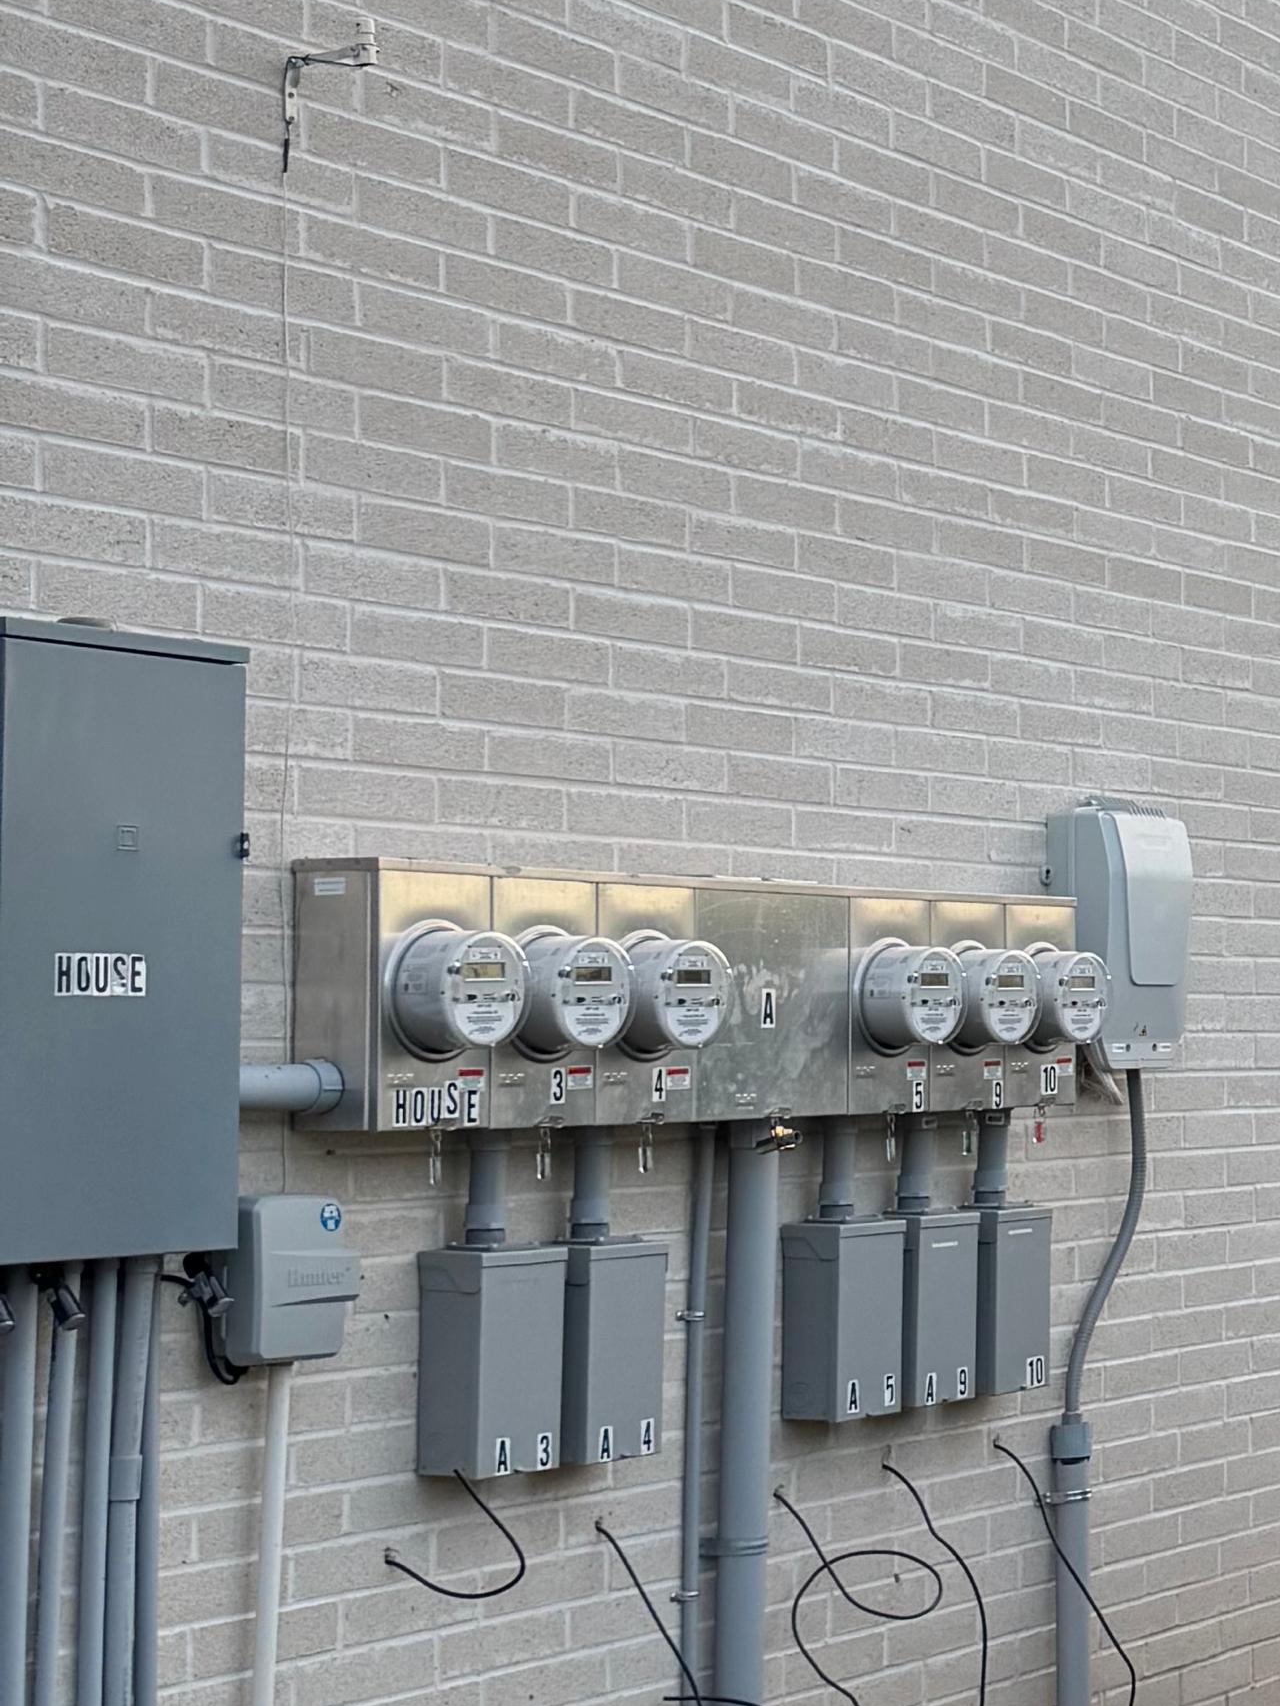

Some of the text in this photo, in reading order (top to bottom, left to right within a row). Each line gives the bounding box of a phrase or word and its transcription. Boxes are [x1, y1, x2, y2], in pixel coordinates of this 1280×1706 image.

[57, 956, 144, 993] HOUSE
[763, 992, 774, 1025] A
[553, 1069, 563, 1101] 3
[654, 1069, 663, 1099] 4
[994, 1081, 1002, 1108] 9
[1043, 1065, 1057, 1093] 10
[395, 1081, 479, 1124] HOUSE
[915, 1082, 923, 1110] 5
[926, 1369, 967, 1403] A 9
[1028, 1358, 1043, 1386] 10
[849, 1375, 894, 1411] A 5
[497, 1435, 550, 1473] A 3
[600, 1421, 652, 1459] A 4
